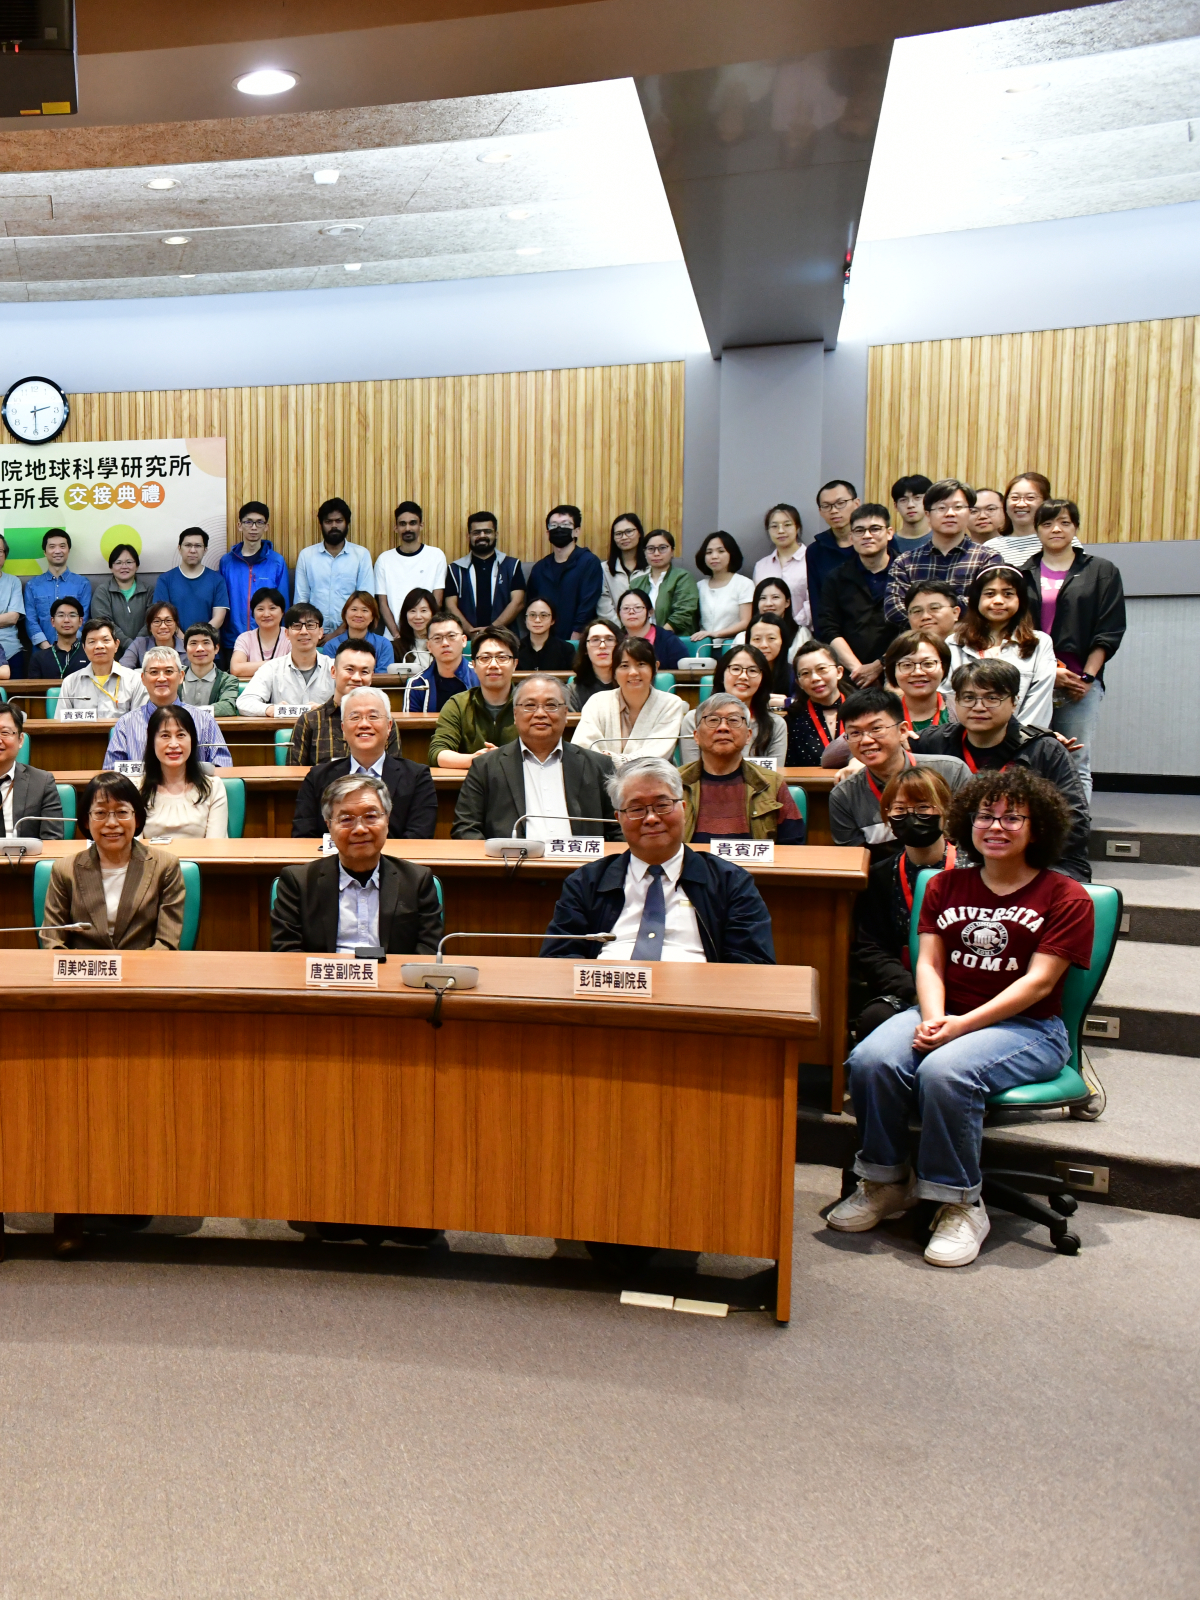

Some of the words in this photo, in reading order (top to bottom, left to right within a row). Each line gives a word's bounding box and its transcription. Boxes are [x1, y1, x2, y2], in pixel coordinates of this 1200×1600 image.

[30, 385, 39, 393] 12
[11, 407, 18, 415] 9
[53, 406, 60, 414] 3
[14, 418, 21, 426] 8
[50, 417, 57, 425] 4
[22, 426, 28, 434] 7
[43, 425, 50, 433] 5
[68, 484, 161, 506] 交接典禮
[63, 710, 95, 720] 貴賓席
[118, 763, 143, 773] 貴賓
[550, 839, 601, 853] 貴賓席
[716, 842, 770, 857] 貴賓席
[936, 905, 1045, 934] UNIVERSITA
[951, 949, 1019, 972] ROMA
[57, 959, 118, 977] 周美吟副院長
[310, 963, 374, 981] 唐堂副院長
[579, 969, 648, 990] 彭信坤副院長
